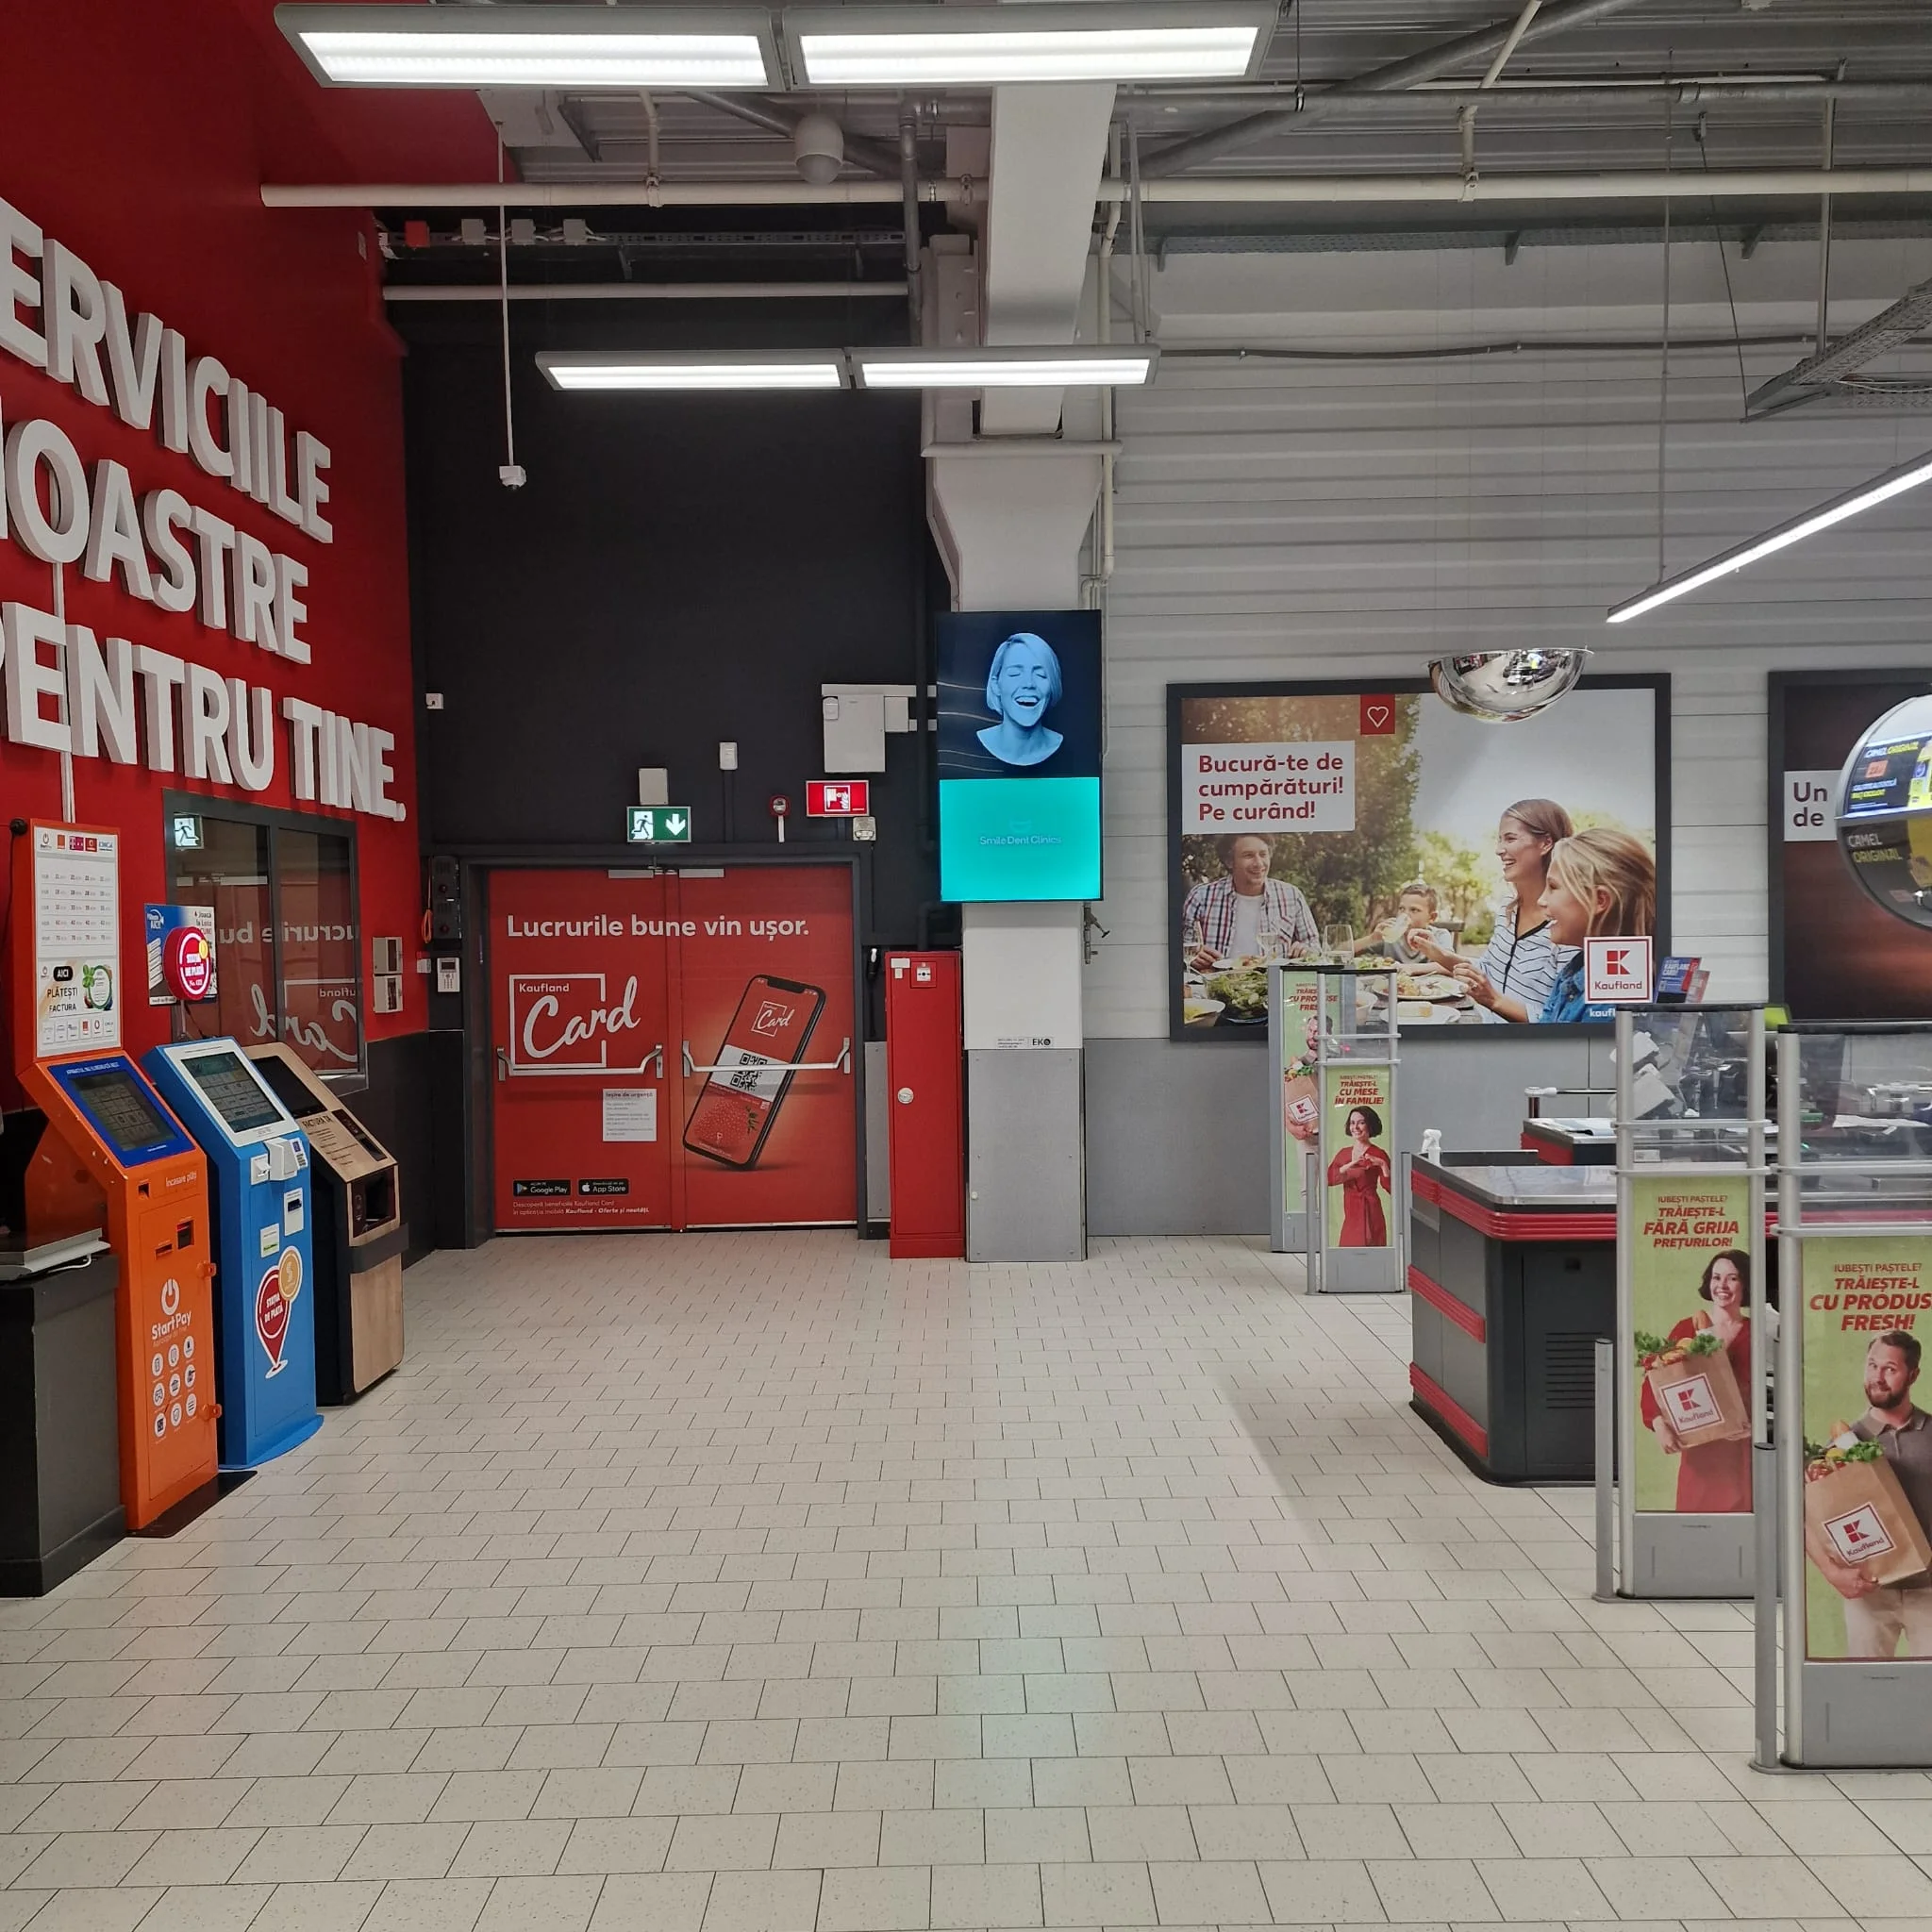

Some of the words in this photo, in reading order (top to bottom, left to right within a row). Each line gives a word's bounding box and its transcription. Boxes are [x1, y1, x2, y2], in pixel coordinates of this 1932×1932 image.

[0, 415, 311, 665] OASTRE
[0, 601, 274, 791] ENTRU
[282, 696, 406, 822] TINE.
[1199, 754, 1308, 773] Bucură-te
[1316, 753, 1343, 771] de
[1198, 776, 1343, 800] cumpărături!
[1793, 782, 1827, 802] Un
[1199, 803, 1225, 821] Pe
[1232, 801, 1315, 821] curând!
[1793, 807, 1824, 827] de
[1848, 833, 1883, 847] CAMEL
[1853, 848, 1903, 863] ORIGINAL
[508, 914, 624, 937] Lucrurile
[632, 913, 696, 937] bune
[704, 915, 741, 936] vin
[750, 920, 809, 941] ușor.
[519, 983, 570, 992] Kaufland
[1594, 981, 1642, 990] Kaufland
[49, 1003, 77, 1012] FACTURA
[524, 975, 641, 1058] Card
[757, 1008, 795, 1030] Card
[1032, 1038, 1051, 1046] EKO
[1345, 1096, 1385, 1105] FAMILIE!
[1354, 1088, 1379, 1096] MESE
[530, 1186, 554, 1194] Google
[1658, 1205, 1725, 1219] TRĂIEȘTE-L
[1643, 1218, 1689, 1235] FĂRĂ
[1693, 1221, 1740, 1234] GRIJA
[1653, 1237, 1733, 1250] PREȚURILOR!
[1834, 1263, 1873, 1274] IUBEȘTI
[1875, 1262, 1923, 1274] PAȘTELE?
[1835, 1274, 1920, 1292] TRĂIEȘTE-L
[1809, 1294, 1840, 1310] CU
[1843, 1292, 1932, 1310] PRODUS
[1841, 1313, 1916, 1331] FRESH!
[1846, 1537, 1885, 1557] Kaufland
